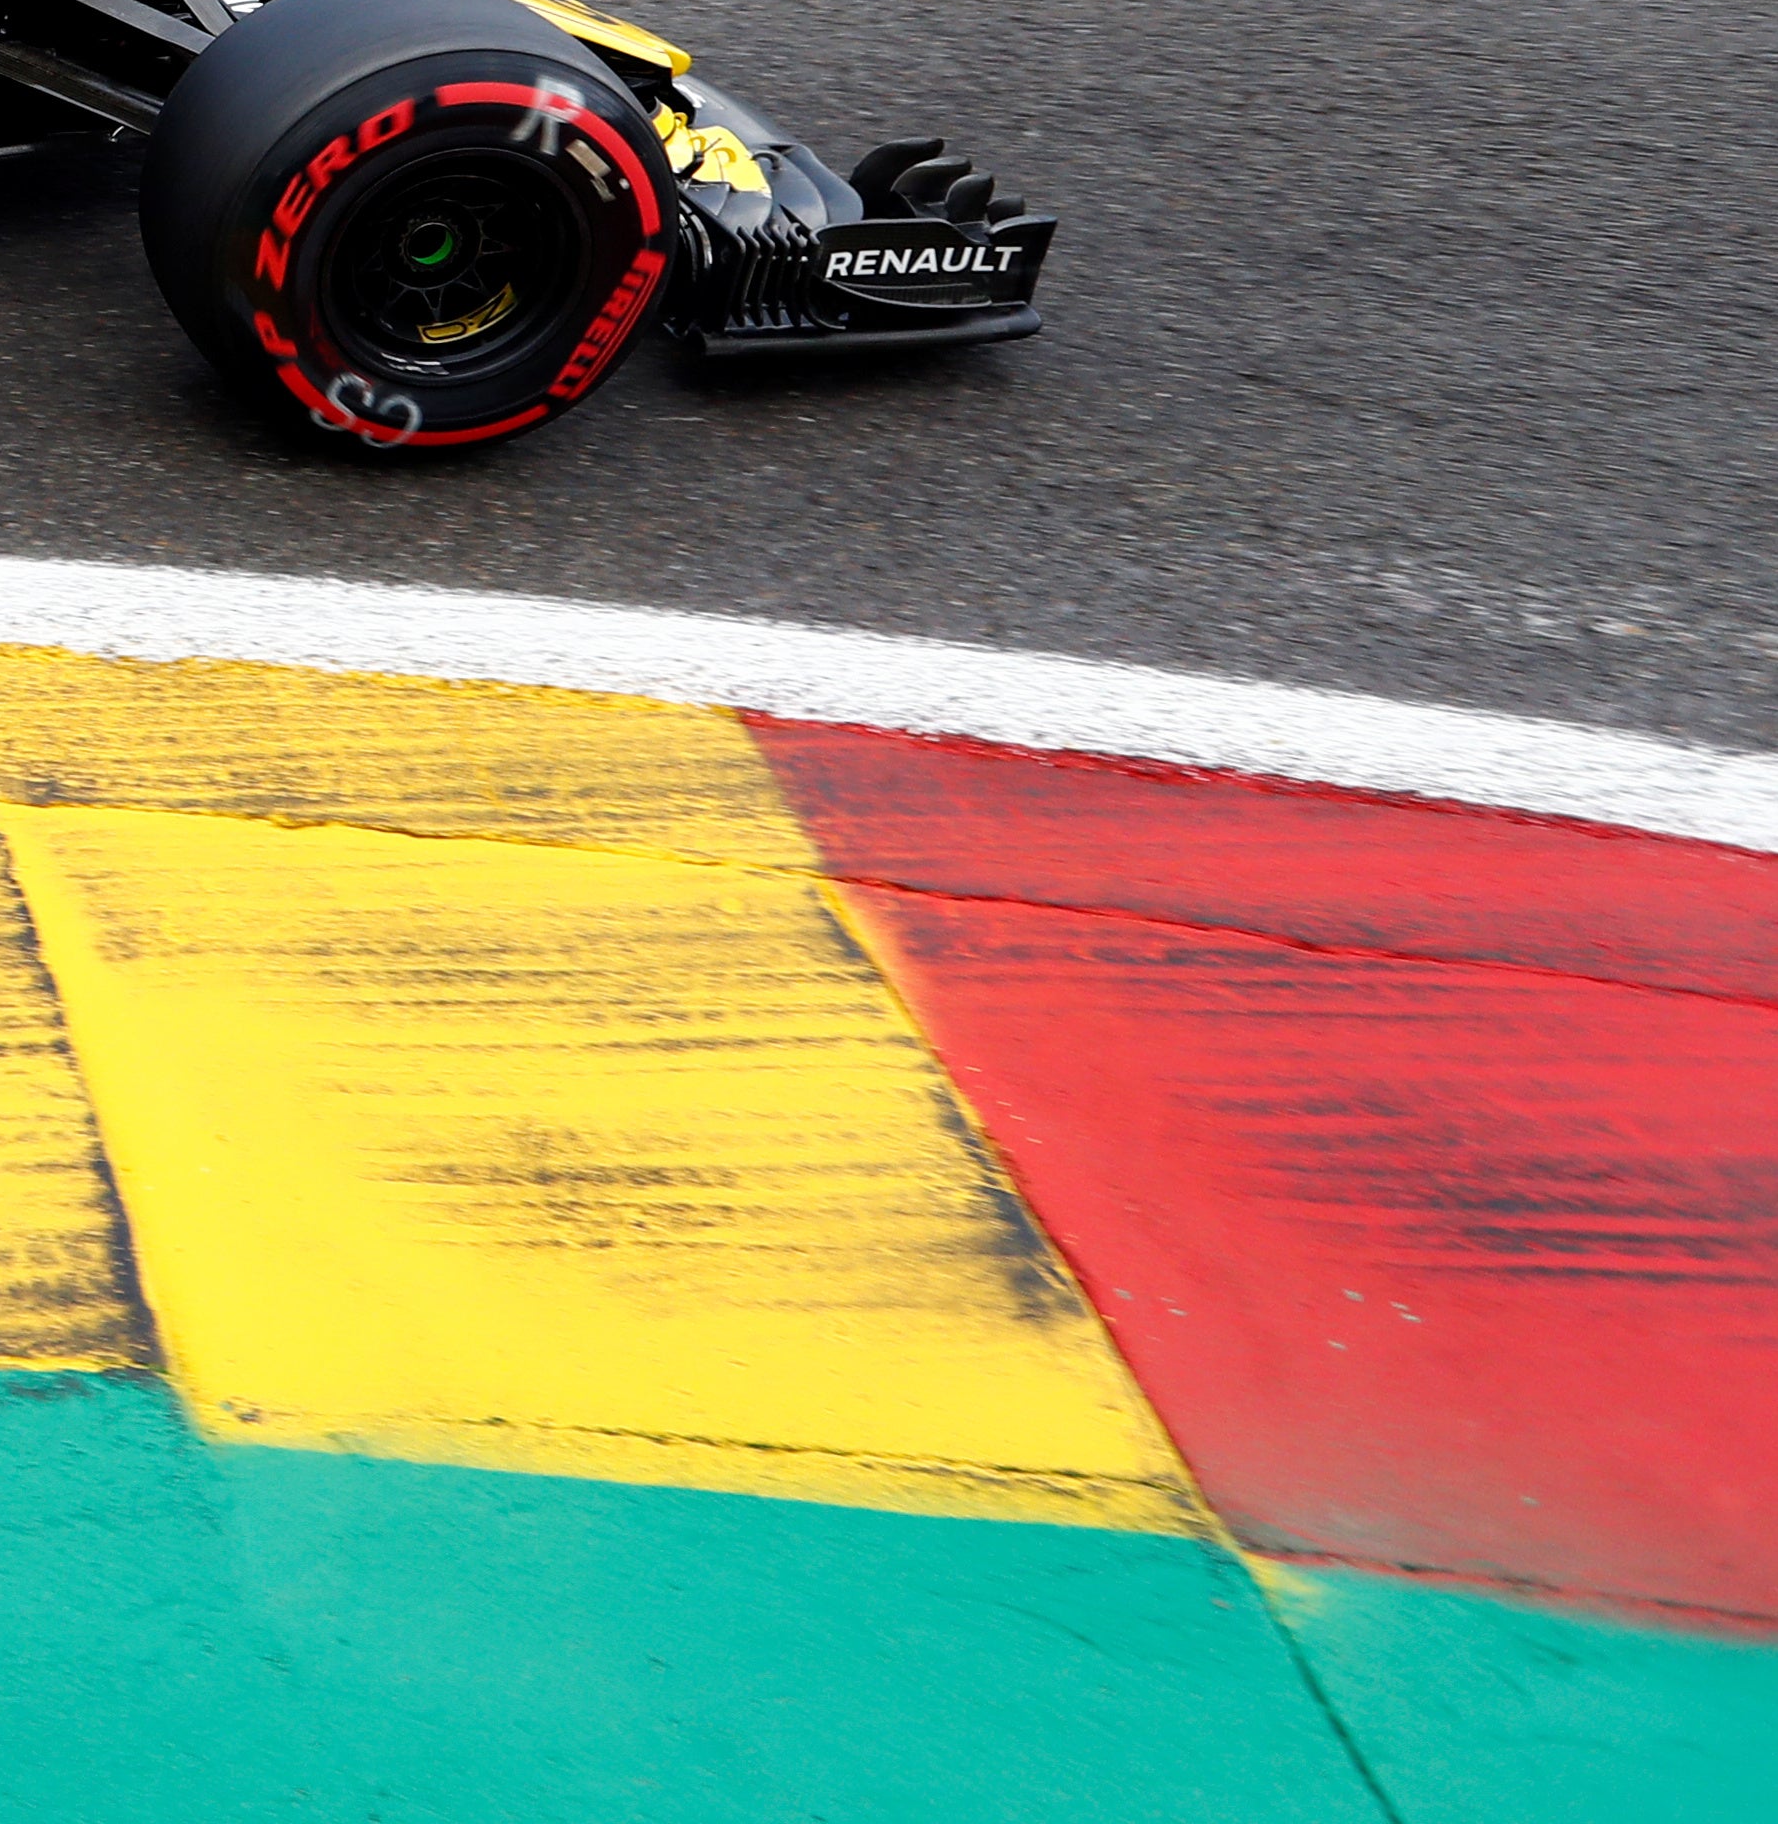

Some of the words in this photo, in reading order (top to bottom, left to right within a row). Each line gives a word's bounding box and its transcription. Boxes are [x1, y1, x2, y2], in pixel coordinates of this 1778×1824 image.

[256, 98, 416, 291] ZERO
[826, 245, 1024, 279] RENAULT
[253, 311, 298, 358] P
[547, 248, 667, 399] PIRELLI
